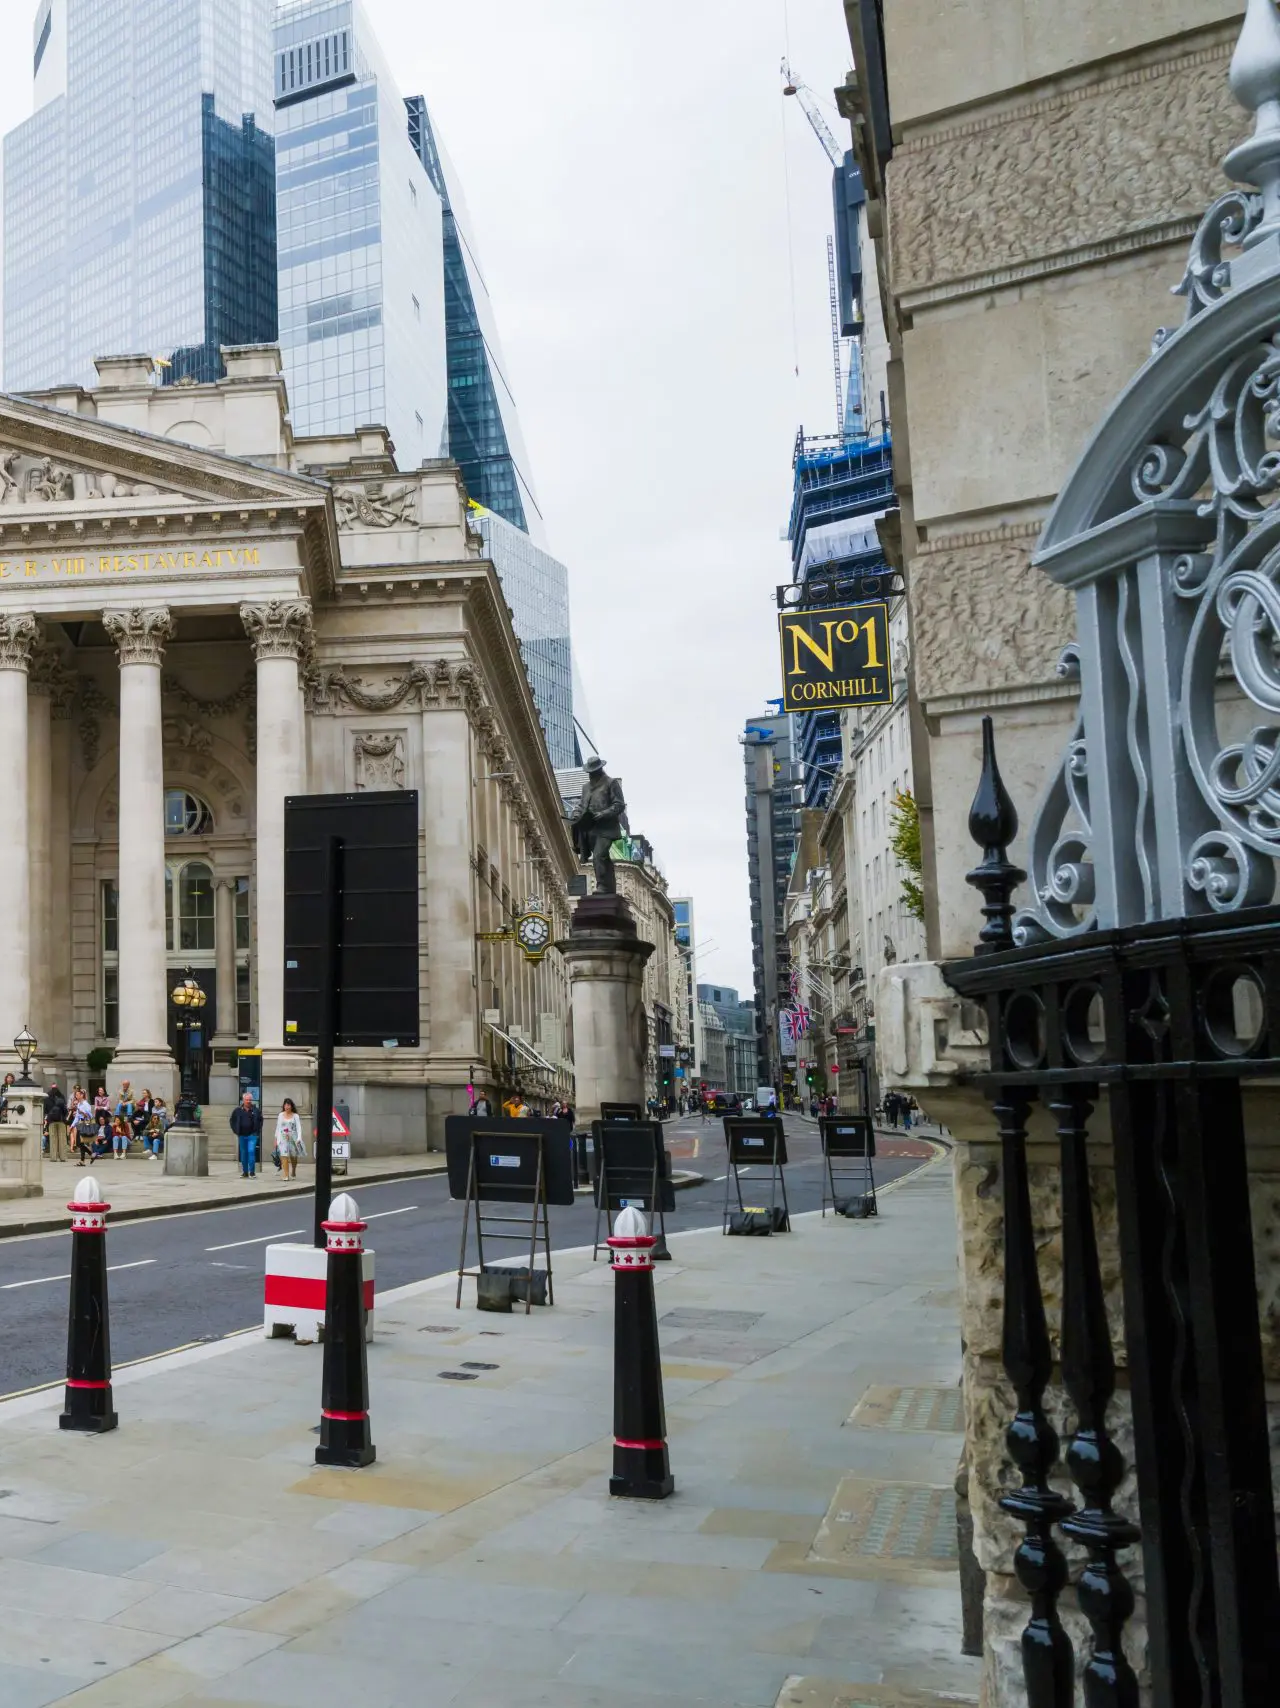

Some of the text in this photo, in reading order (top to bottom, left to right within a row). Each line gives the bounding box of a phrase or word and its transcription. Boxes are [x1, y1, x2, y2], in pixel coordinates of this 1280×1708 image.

[24, 560, 38, 577] R
[52, 557, 85, 575] VIII
[99, 547, 261, 574] RESTAVRATVM
[791, 677, 883, 701] CORNHILL
